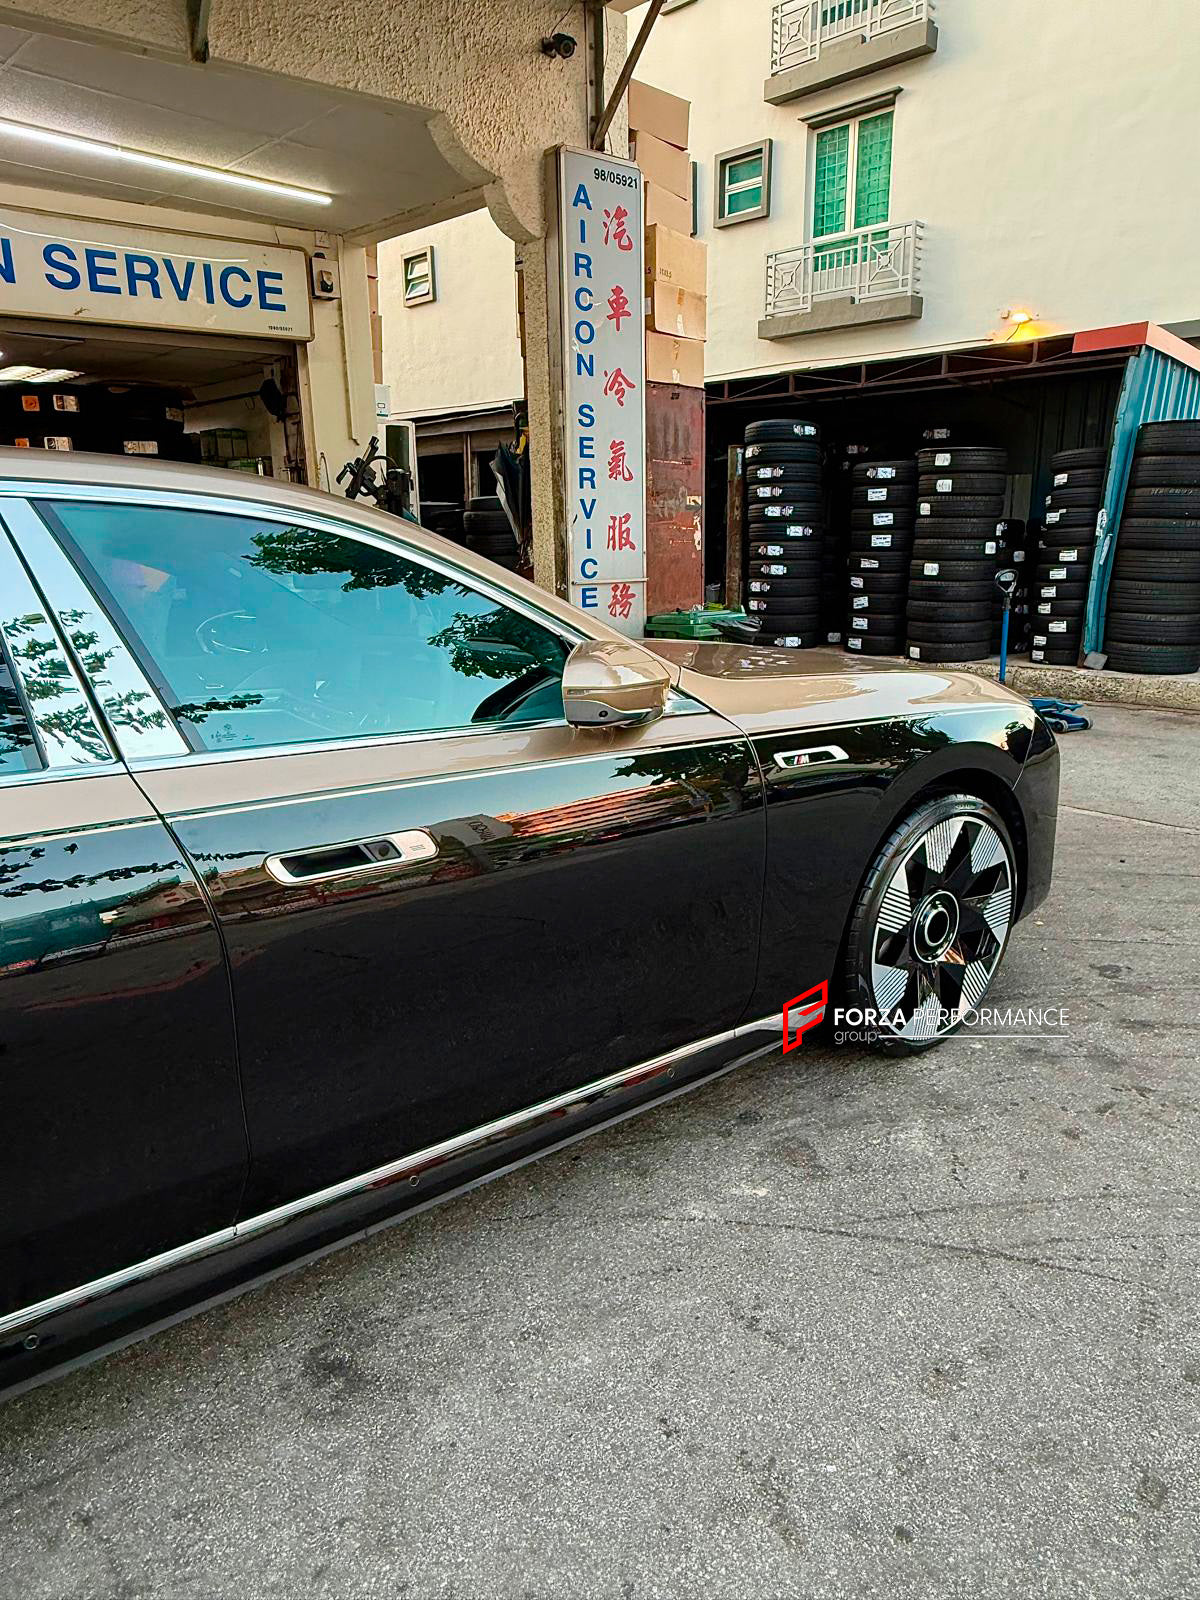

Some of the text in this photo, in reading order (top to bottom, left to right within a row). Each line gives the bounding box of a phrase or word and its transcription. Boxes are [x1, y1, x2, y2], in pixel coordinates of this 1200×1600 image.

[42, 243, 287, 313] SERVICE
[593, 168, 638, 190] 98/05921
[572, 183, 599, 609] AIRCON SERVICE
[602, 205, 637, 620] 汽車冷氣服務
